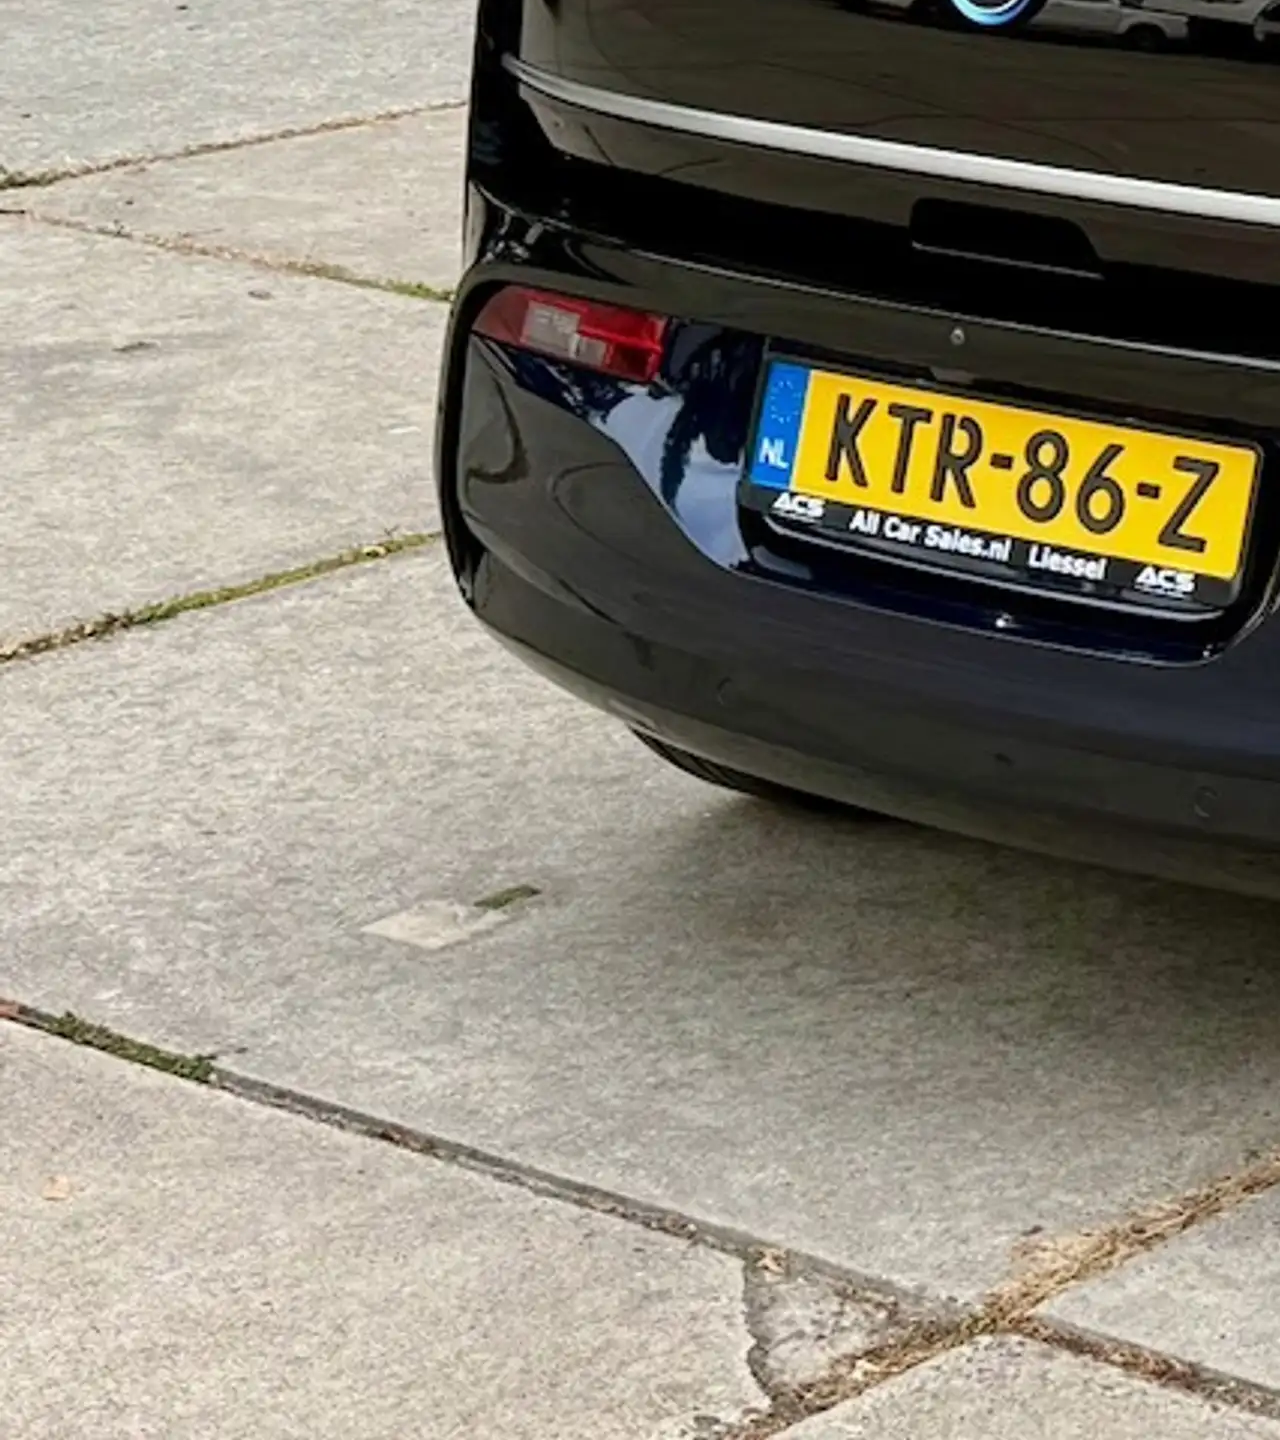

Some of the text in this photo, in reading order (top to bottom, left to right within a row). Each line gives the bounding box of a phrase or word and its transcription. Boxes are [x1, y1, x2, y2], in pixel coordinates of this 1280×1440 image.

[759, 437, 790, 469] NL
[824, 392, 1221, 554] KTR-86-Z
[771, 492, 826, 518] ACS
[849, 509, 881, 536] All
[884, 516, 921, 544] Car
[924, 525, 1012, 562] Sales.nl
[1028, 545, 1108, 580] Liessel
[1135, 566, 1195, 593] ACS
